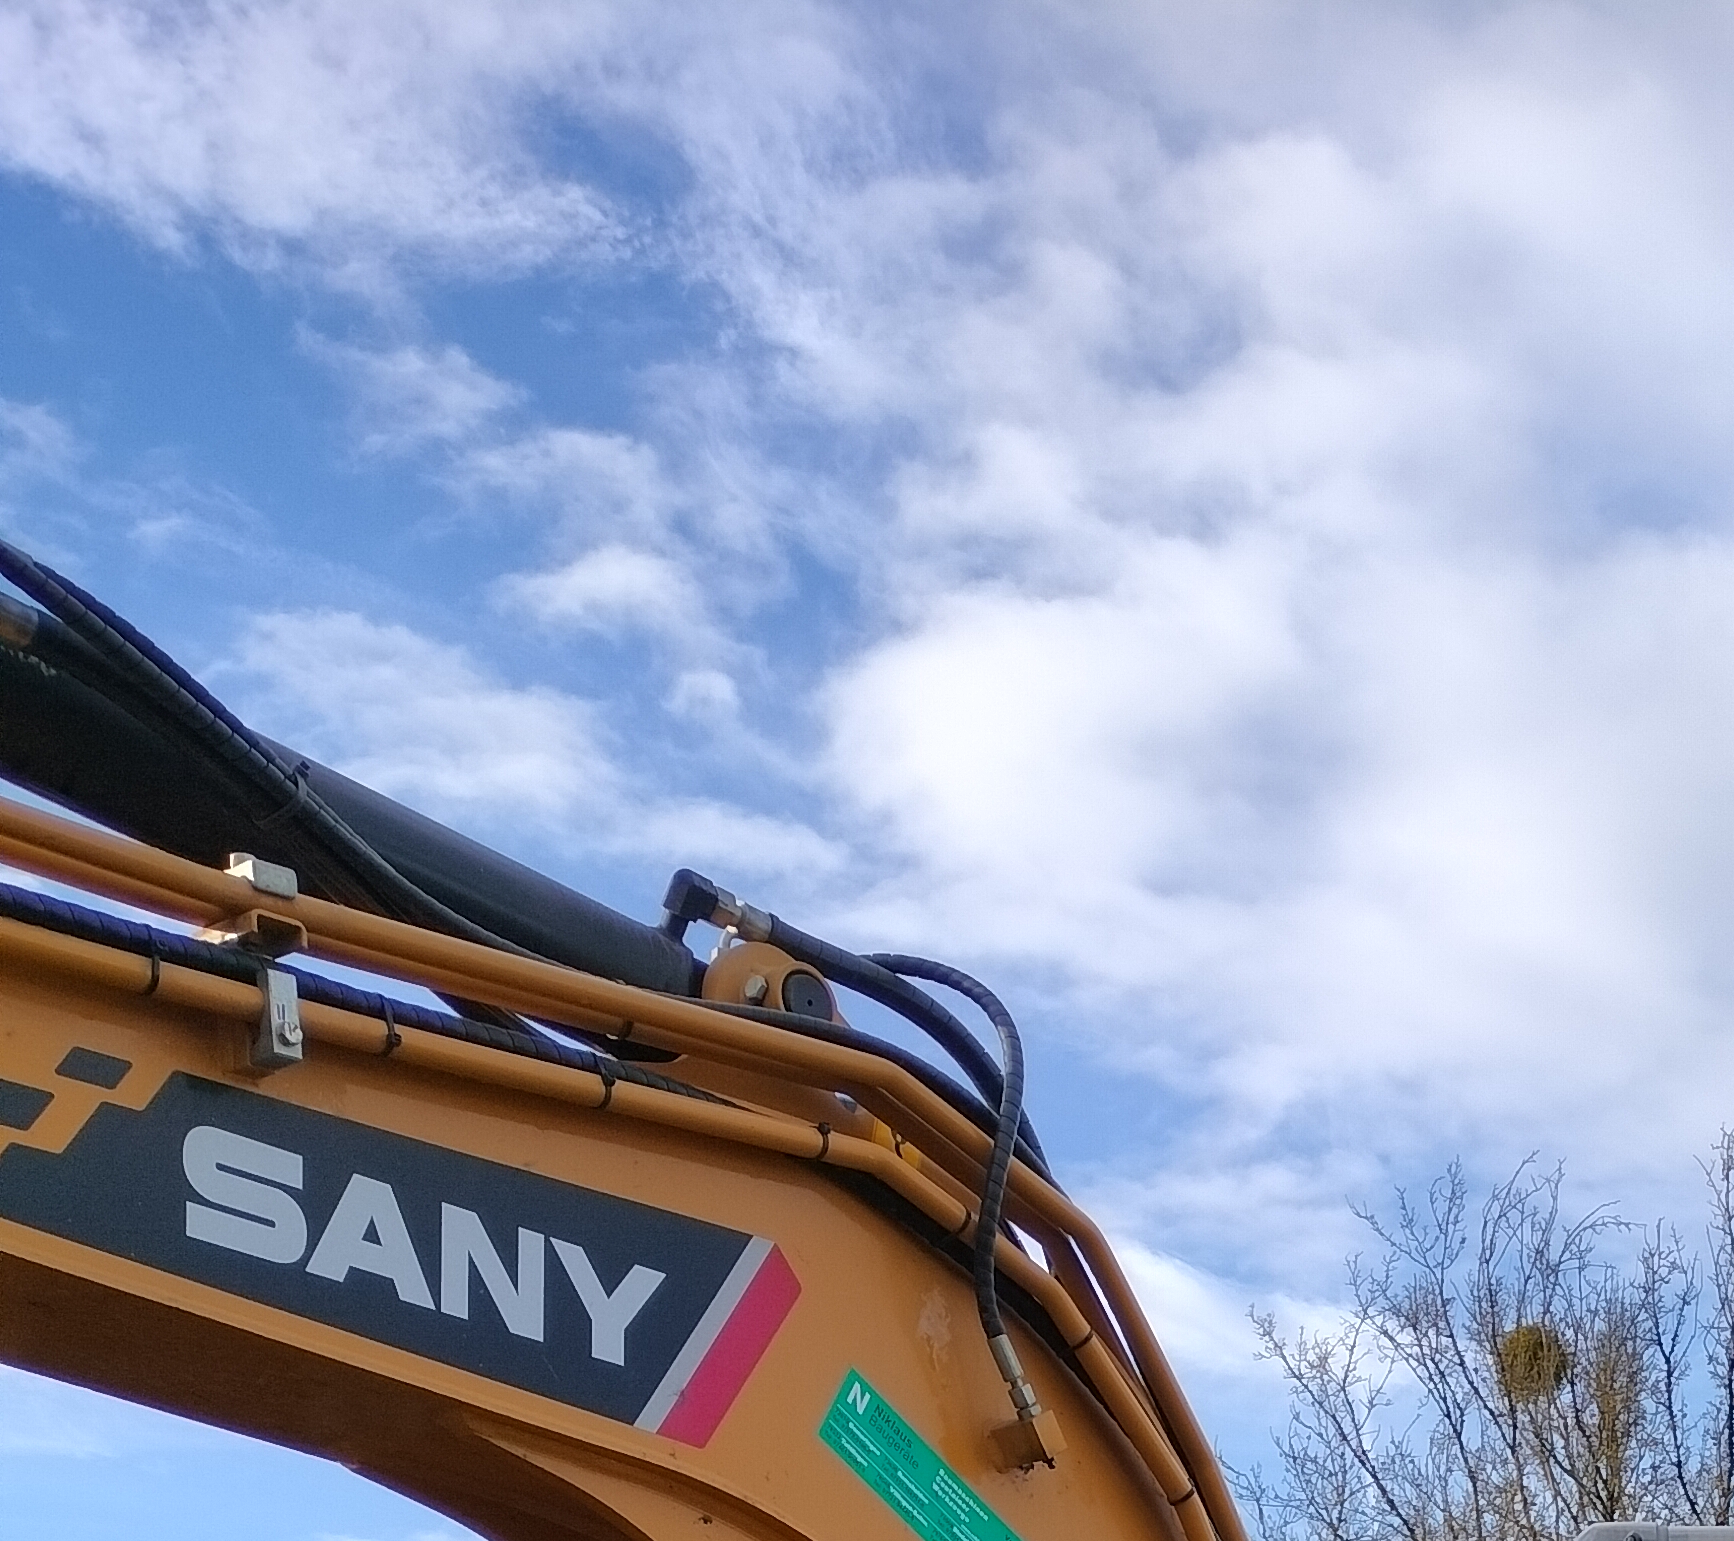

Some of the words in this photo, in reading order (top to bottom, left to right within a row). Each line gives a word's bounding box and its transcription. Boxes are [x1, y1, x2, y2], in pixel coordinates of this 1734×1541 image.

[183, 1125, 665, 1366] SANY
[846, 1380, 871, 1415] N
[873, 1402, 915, 1449] Niklaus
